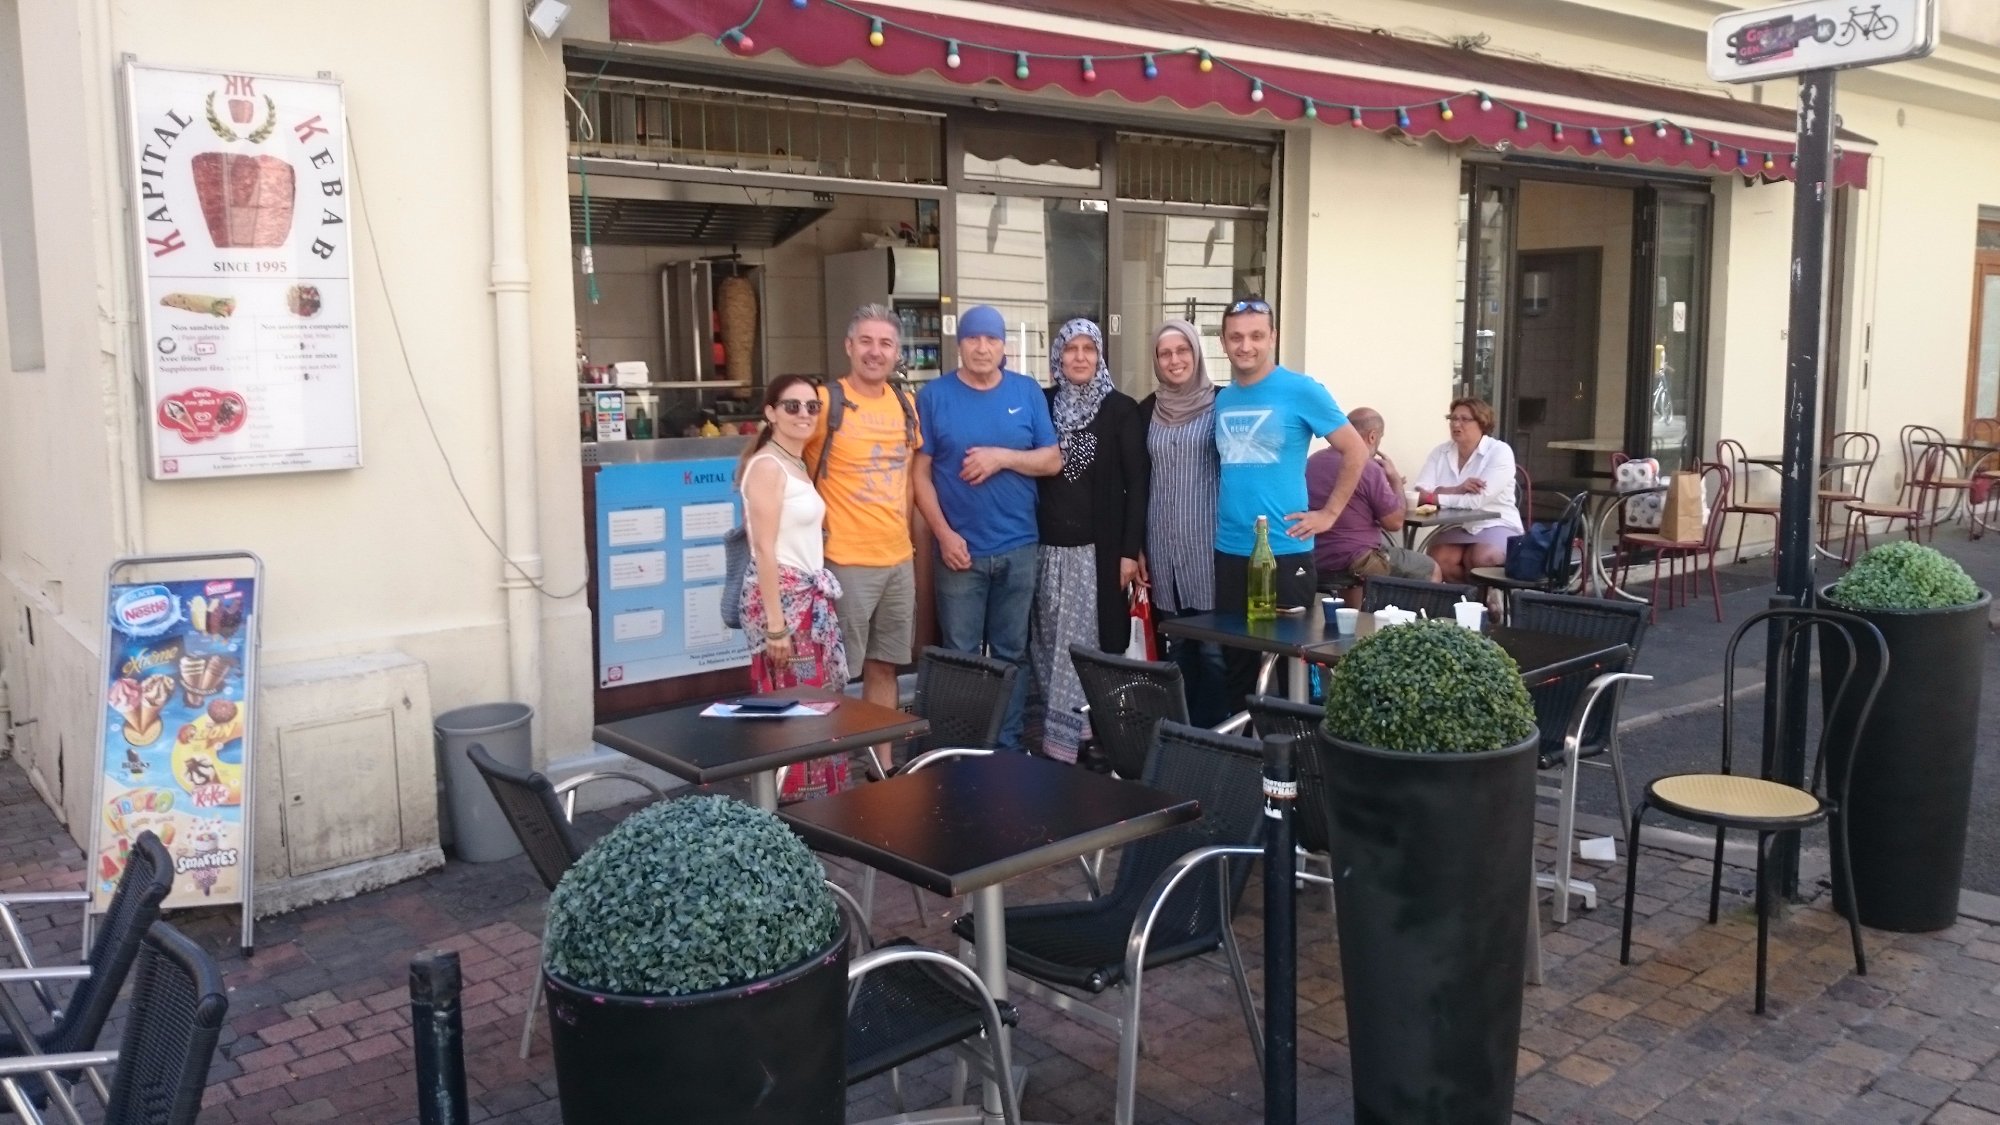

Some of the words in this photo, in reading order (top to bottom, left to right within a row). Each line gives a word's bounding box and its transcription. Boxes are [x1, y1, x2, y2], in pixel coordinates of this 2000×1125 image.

[141, 109, 193, 258] KAPITAL
[294, 115, 344, 261] KEBAB
[214, 261, 250, 272] SINCE
[256, 262, 287, 273] 1995
[1230, 425, 1250, 433] BLUE
[684, 470, 726, 485] KAPITAL
[124, 598, 169, 621] Nestlé
